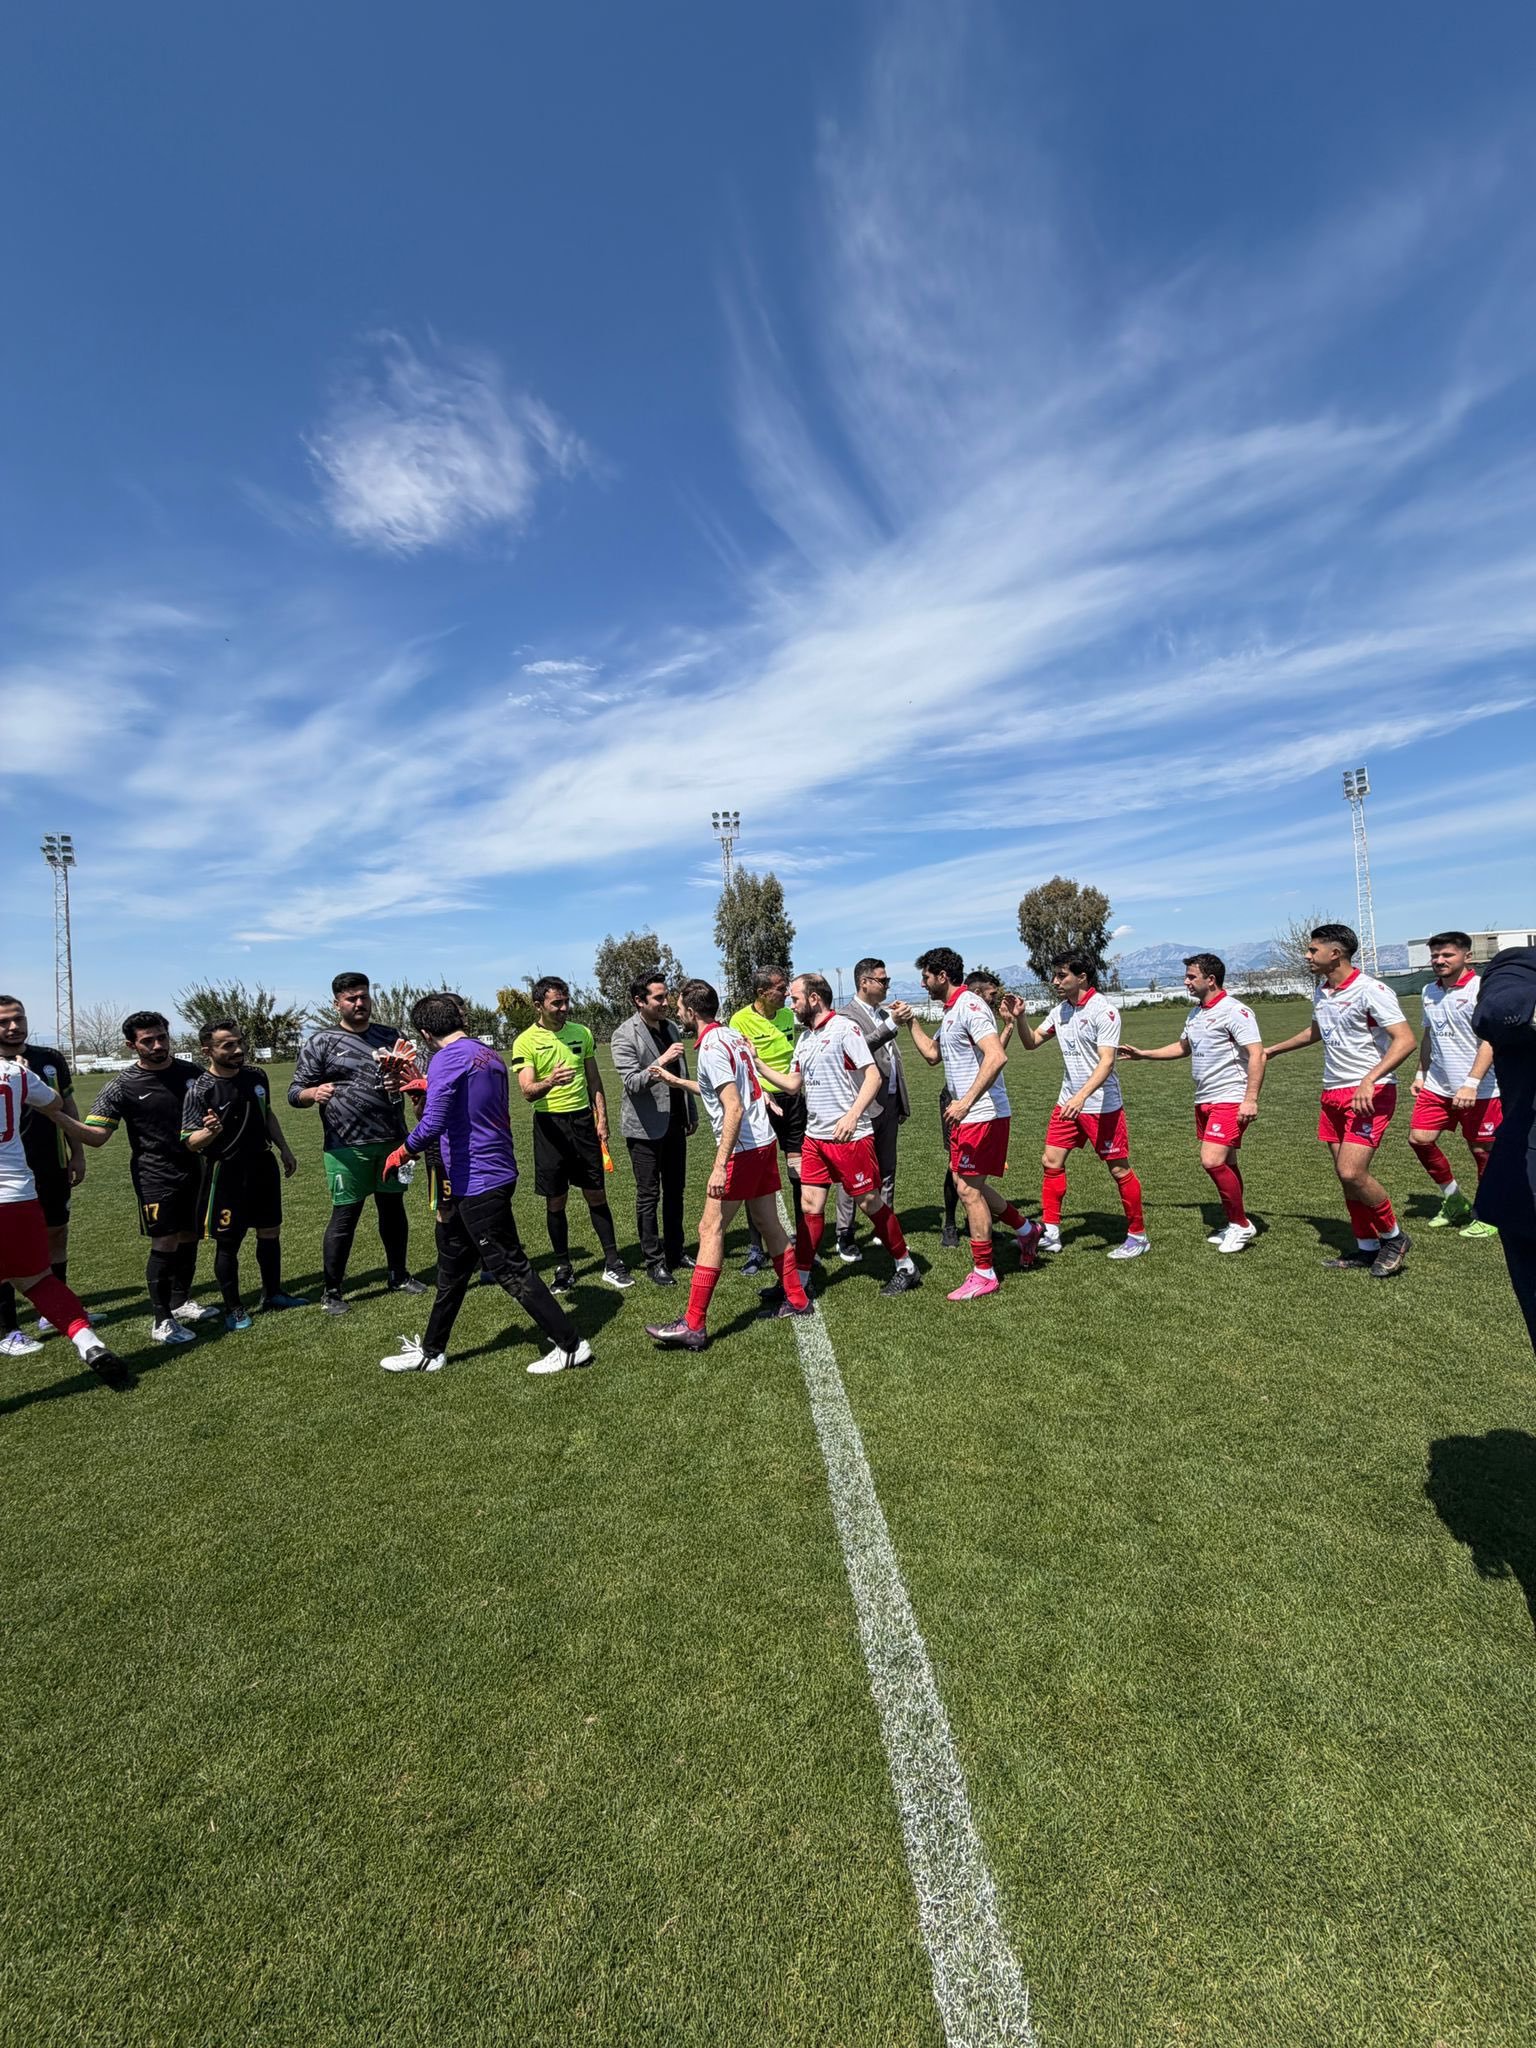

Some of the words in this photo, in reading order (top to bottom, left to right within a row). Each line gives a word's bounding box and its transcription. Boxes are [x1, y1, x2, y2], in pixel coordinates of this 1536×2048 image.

[443, 1180, 452, 1196] 5
[142, 1202, 160, 1222] 17
[220, 1208, 232, 1226] 3
